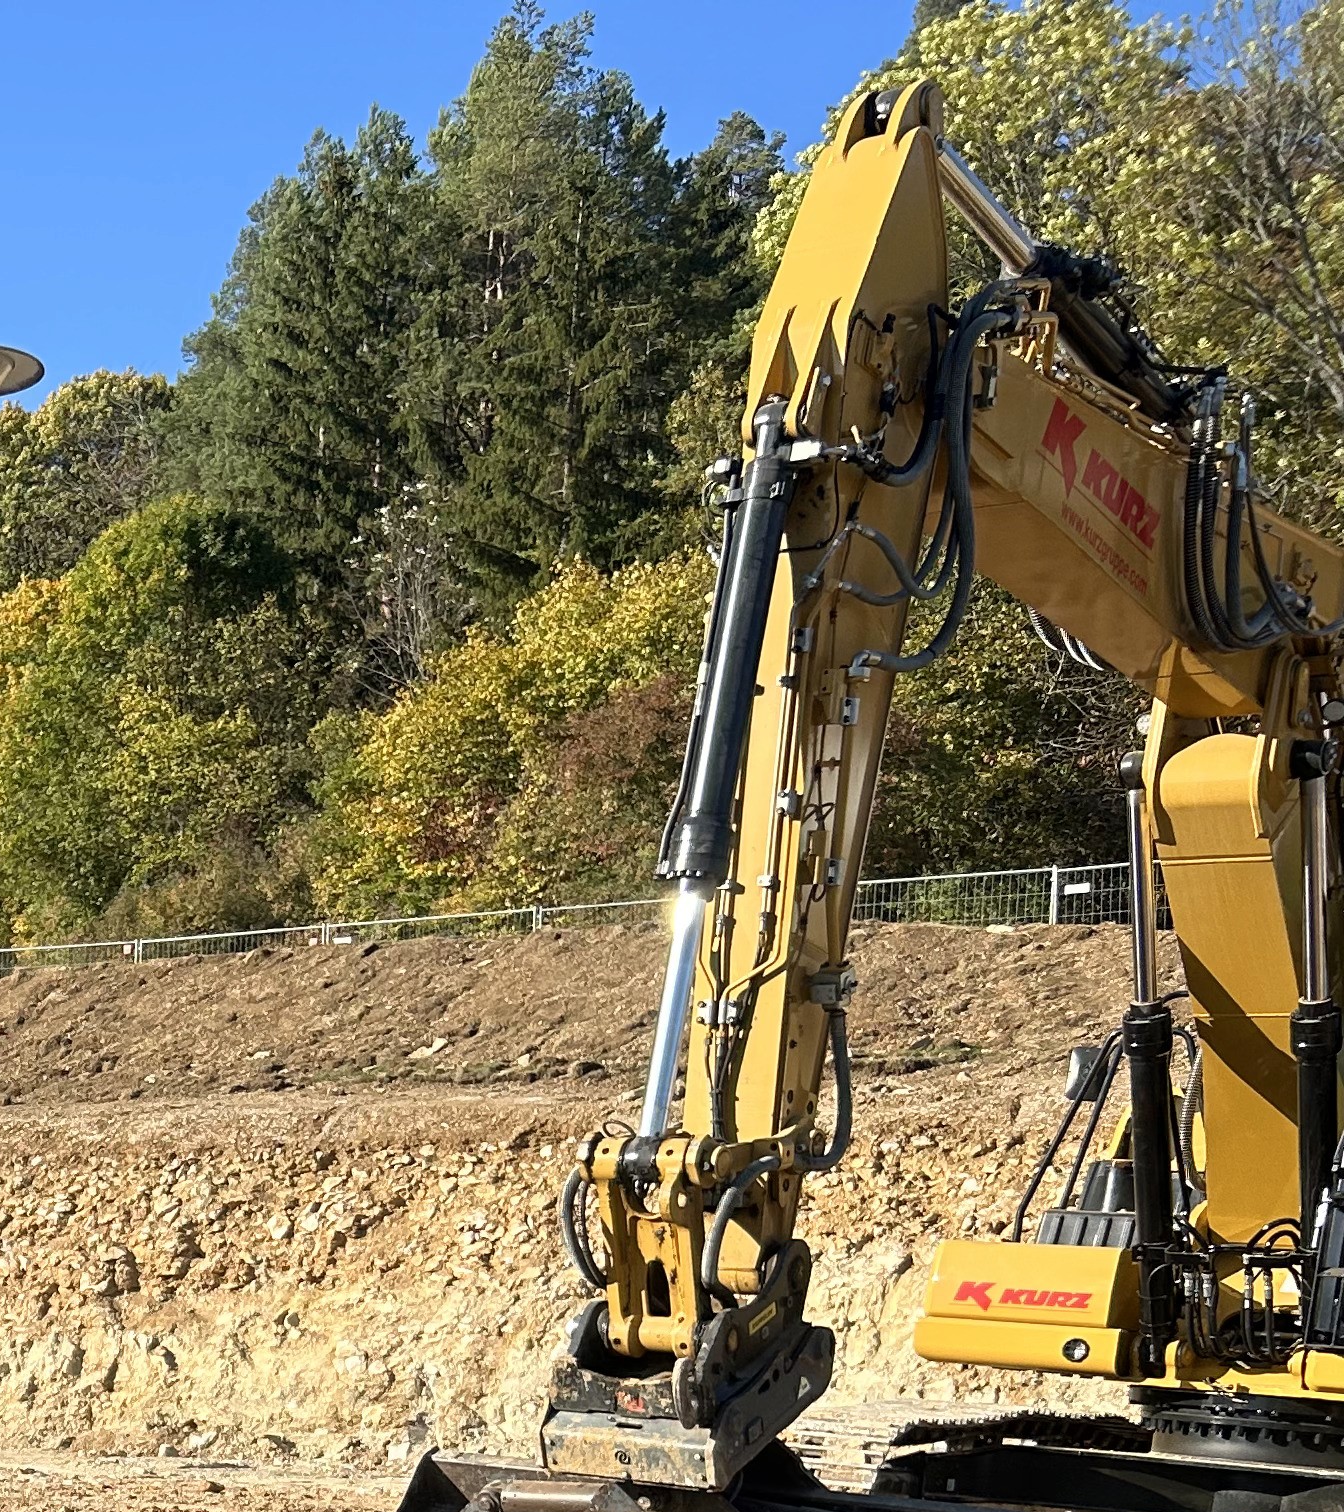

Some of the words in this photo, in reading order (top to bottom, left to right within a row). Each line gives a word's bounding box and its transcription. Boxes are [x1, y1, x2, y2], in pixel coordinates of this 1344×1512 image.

[1081, 448, 1162, 551] KURZ
[1062, 503, 1148, 597] www.kurzgruppe.com
[998, 1288, 1092, 1309] KURZ
